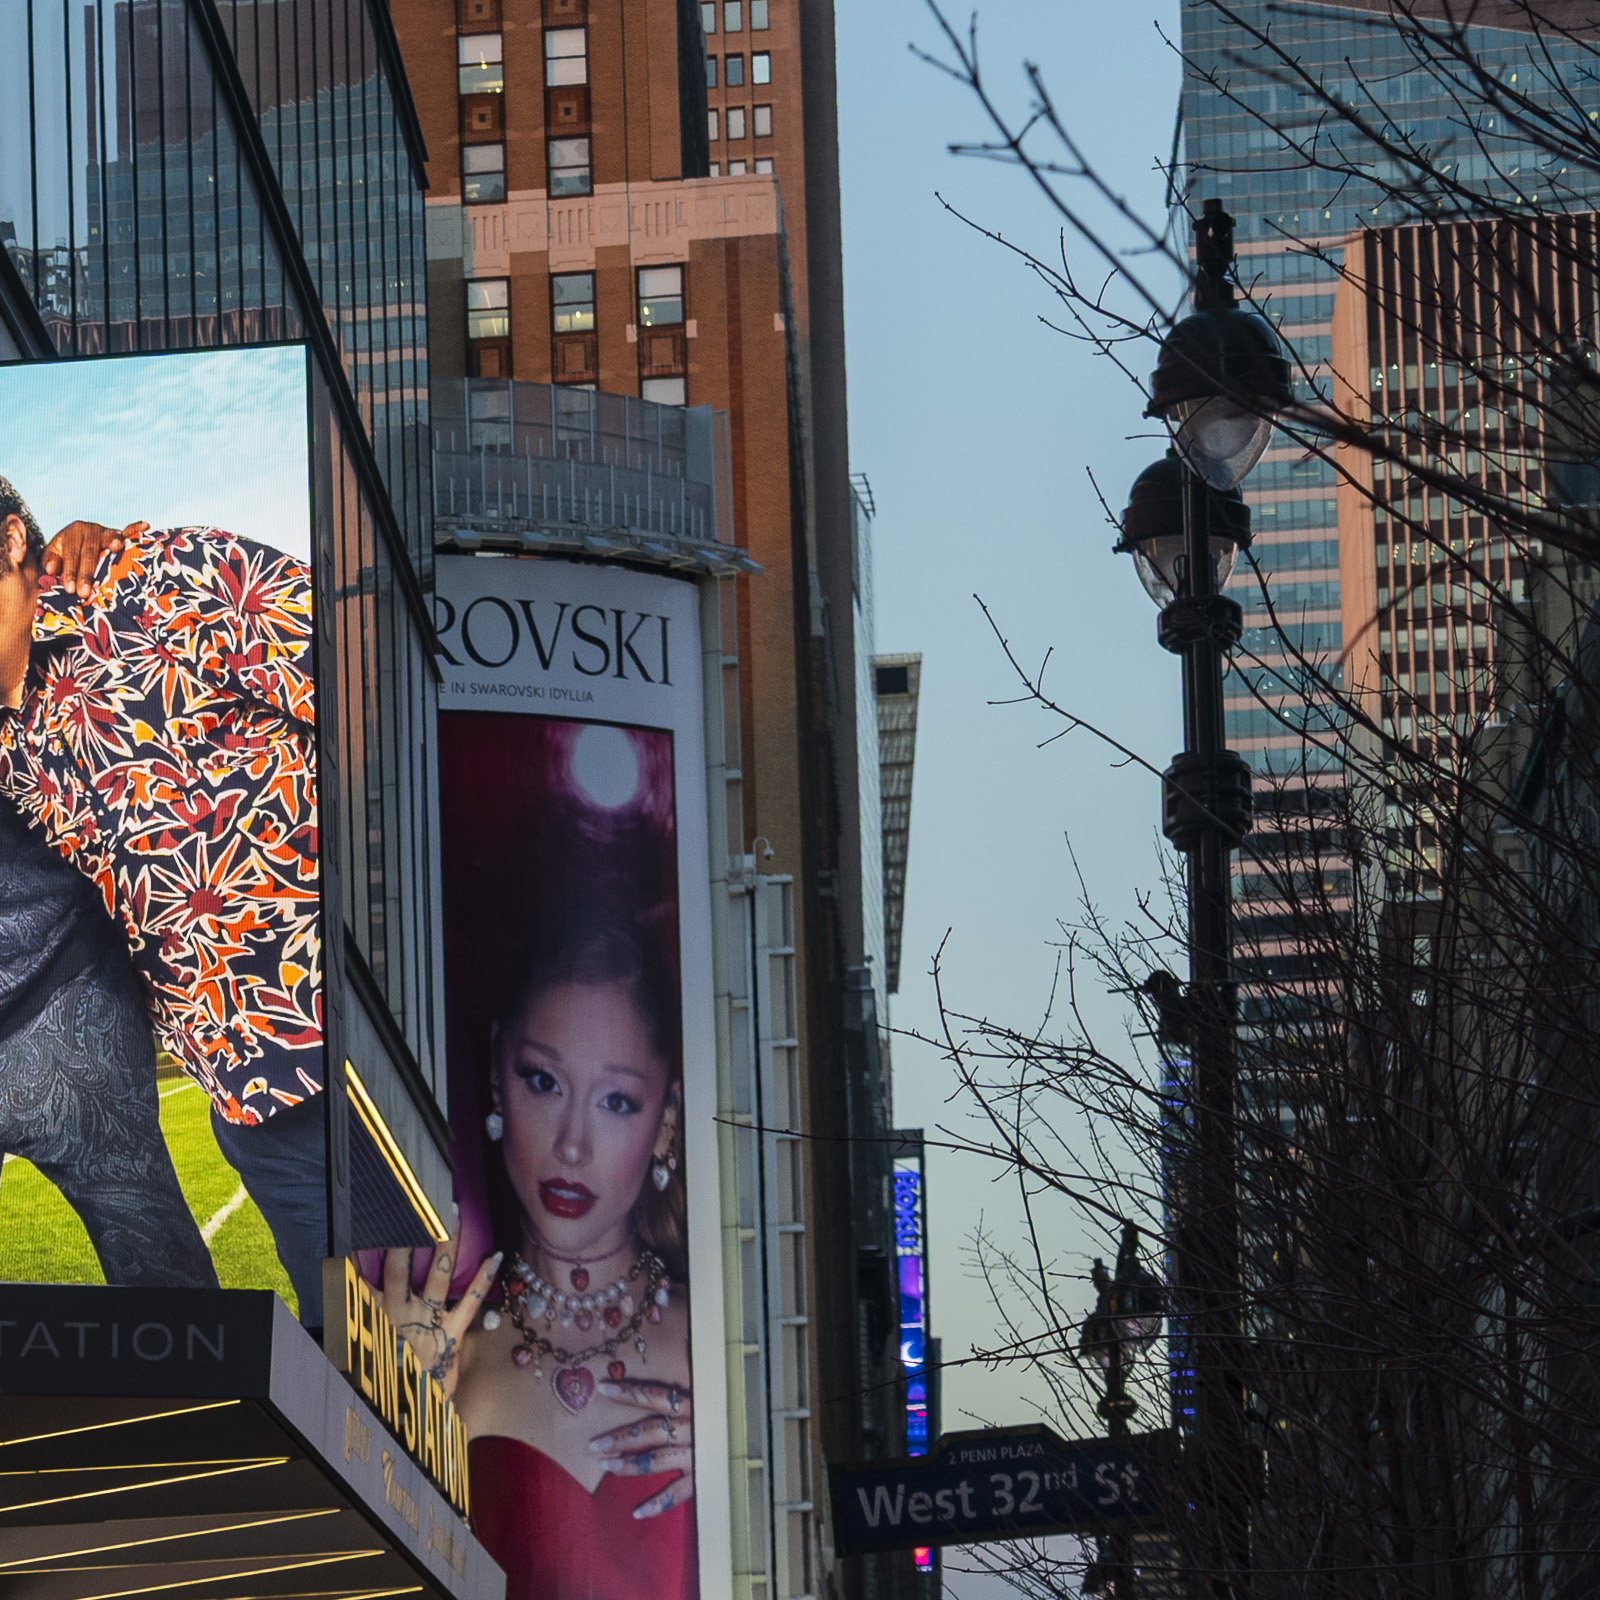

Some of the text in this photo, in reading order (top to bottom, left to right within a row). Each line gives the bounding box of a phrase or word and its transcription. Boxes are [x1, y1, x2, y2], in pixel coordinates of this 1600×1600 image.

[452, 683, 465, 693] IN
[470, 684, 544, 698] SWAROVSKI
[550, 688, 593, 702] IDYLLIA
[345, 1256, 400, 1434] PENN
[403, 1340, 469, 1517] STATION
[949, 1443, 1045, 1465] 2 PENN PLAZA
[856, 1461, 1140, 1528] West 32nd St
